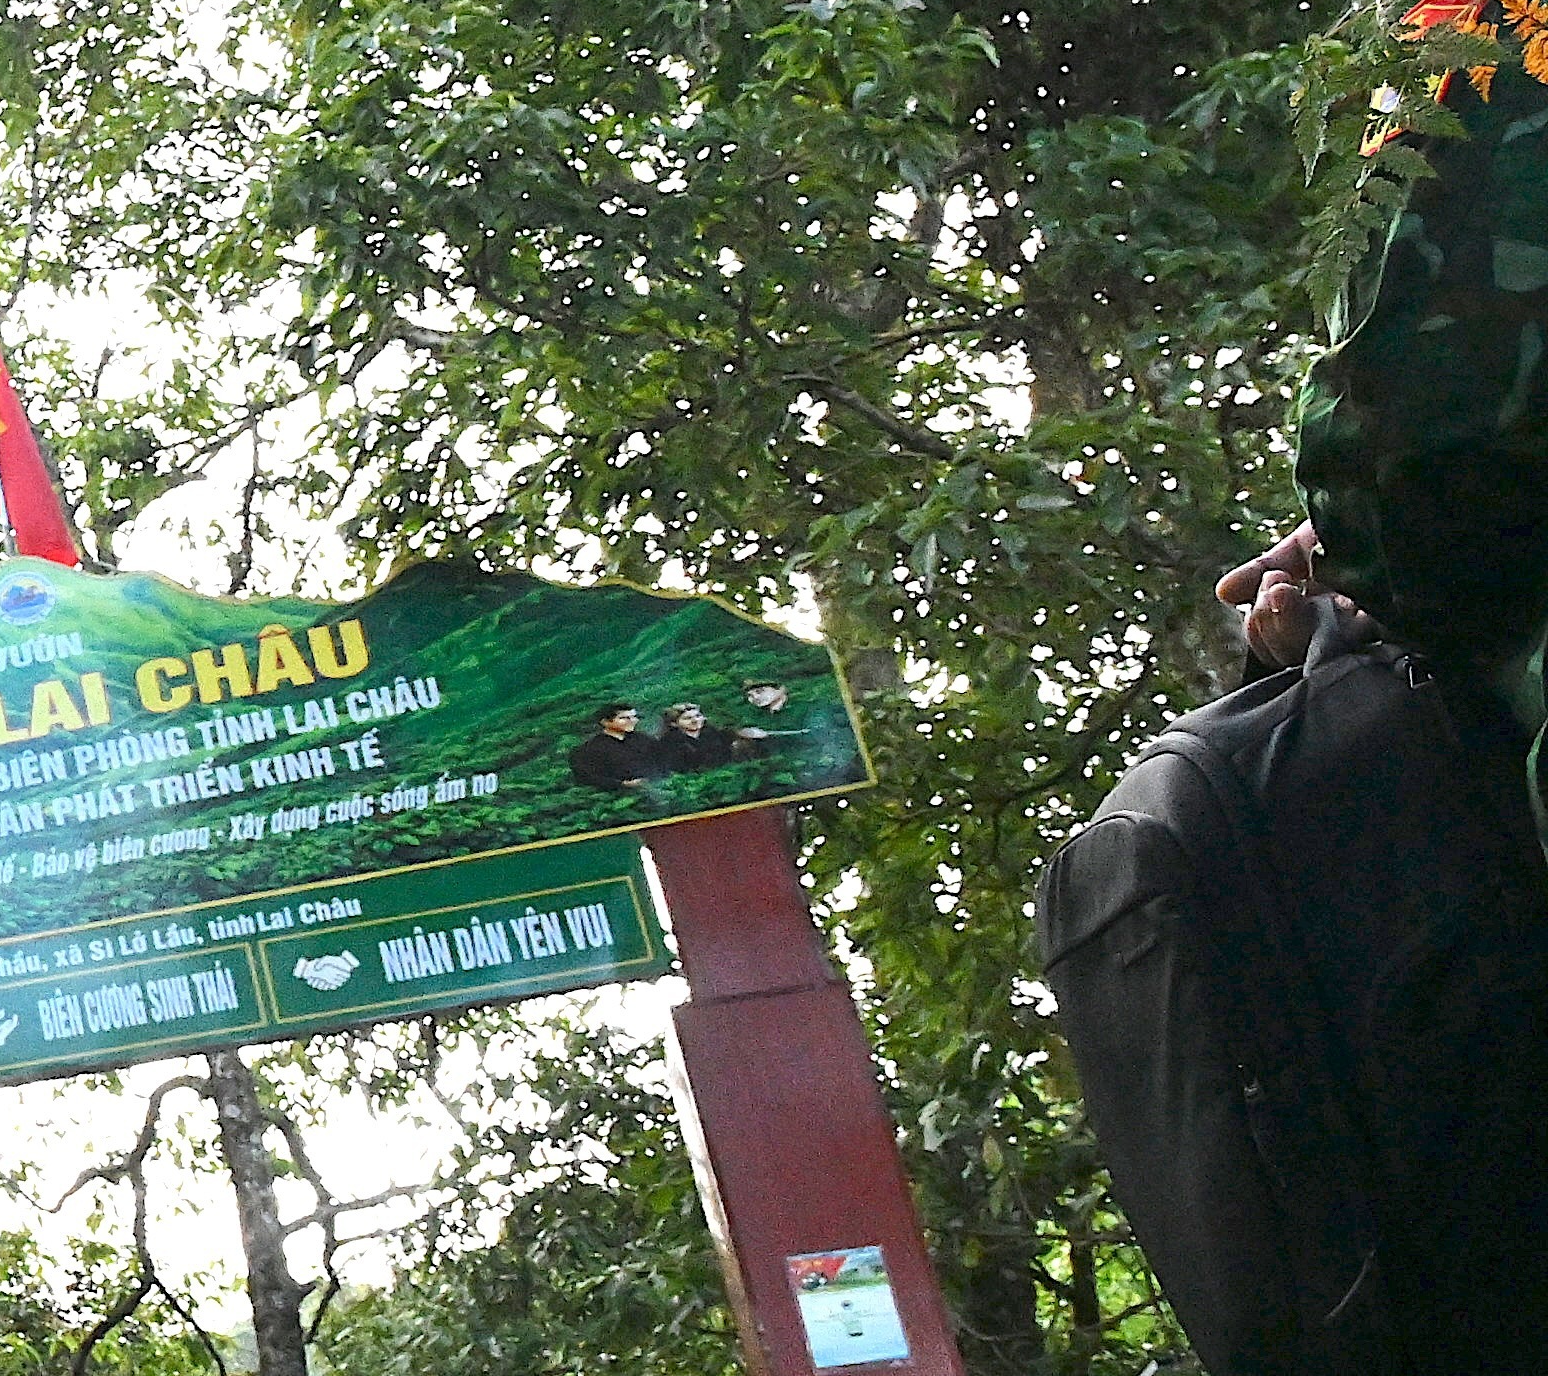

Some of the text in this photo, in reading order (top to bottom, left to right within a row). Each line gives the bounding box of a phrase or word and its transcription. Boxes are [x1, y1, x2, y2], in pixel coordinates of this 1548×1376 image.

[134, 619, 370, 713] CHÂU
[73, 728, 190, 776] PHÒNG
[195, 708, 277, 750] TỈNH
[285, 699, 338, 736] LAI
[345, 676, 442, 720] CHÂU
[51, 781, 136, 826] PHÁT
[144, 756, 246, 808] TRIỂN
[253, 745, 336, 789] KINH
[340, 727, 386, 773] TẾ
[31, 846, 70, 879] Bảo
[74, 841, 99, 874] vệ
[102, 833, 146, 866] biên
[228, 811, 267, 842] Xây
[325, 790, 375, 825] cuộc
[379, 781, 430, 815] sống
[434, 770, 468, 804] ấm
[472, 772, 500, 797] no
[53, 943, 85, 968] xã
[208, 913, 256, 941] tỉnh
[256, 906, 295, 932] Lai
[298, 896, 364, 924] Châu
[378, 902, 614, 984] NHÂN DÂN YÊN VUI
[38, 987, 85, 1042] BIÊN
[82, 981, 149, 1034] CƯƠNG
[145, 975, 196, 1024] SINH
